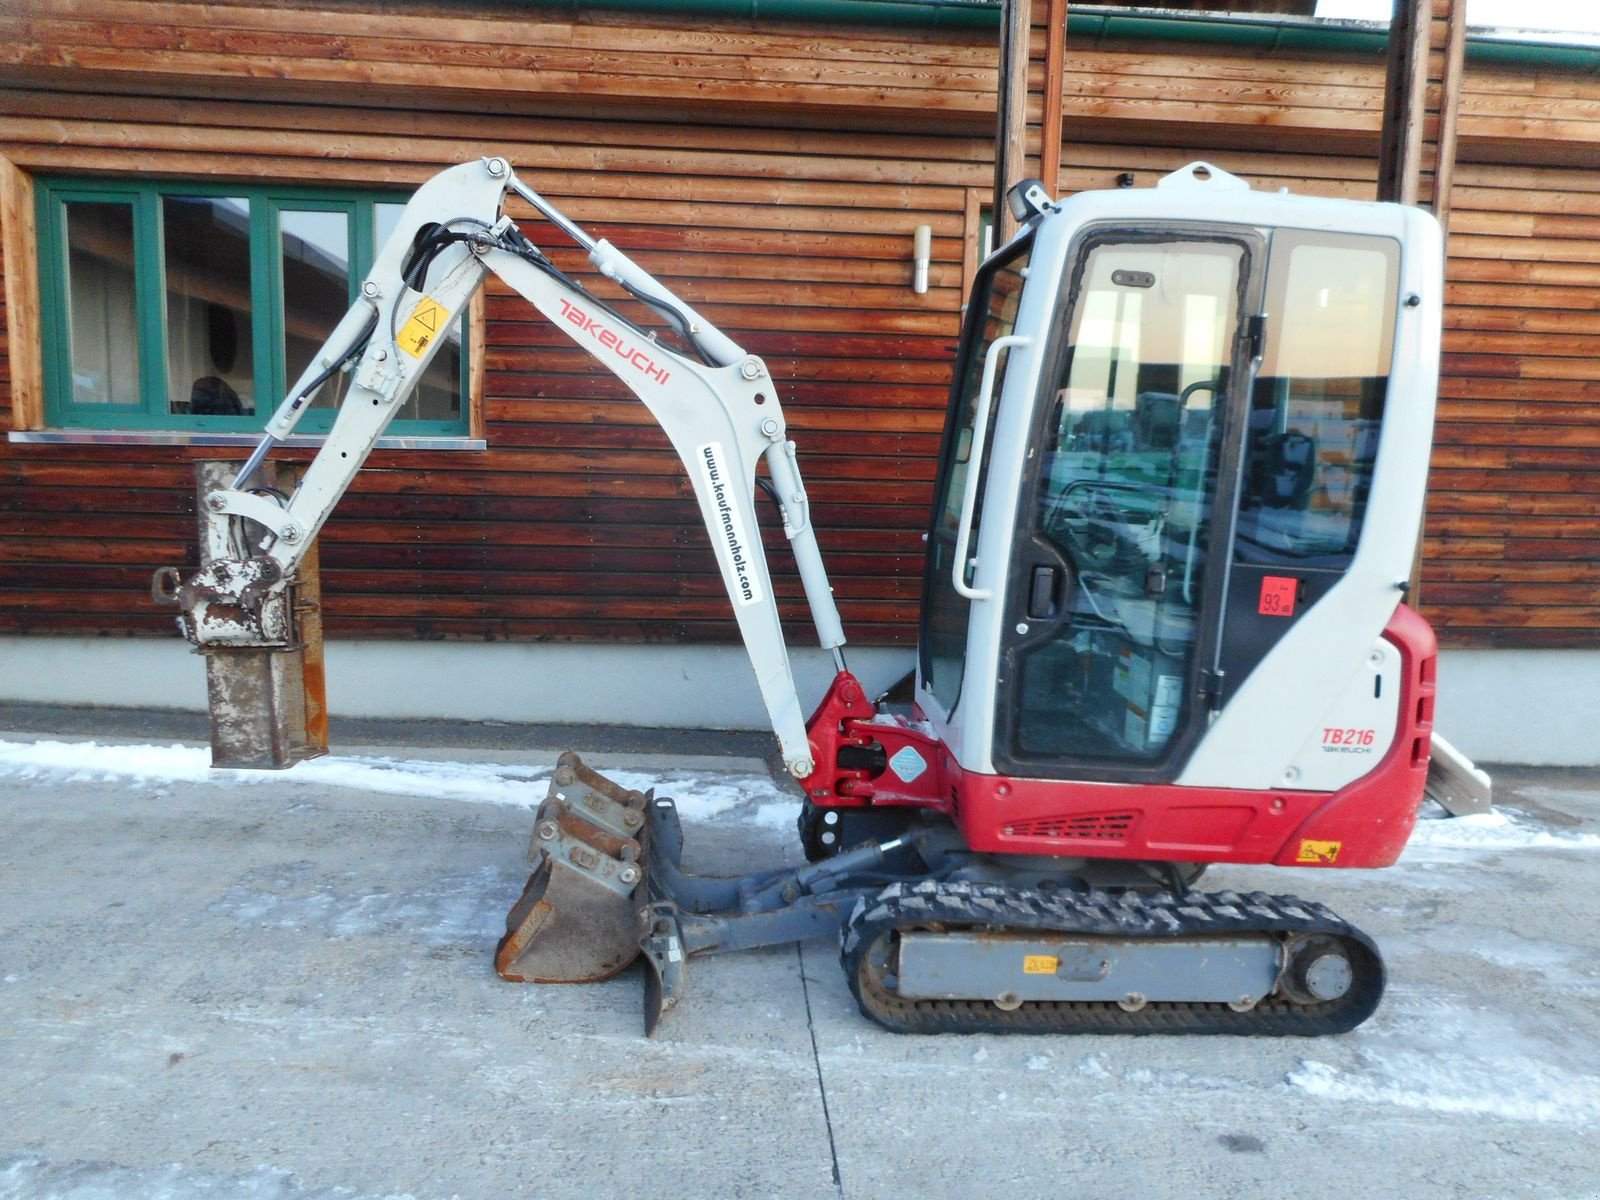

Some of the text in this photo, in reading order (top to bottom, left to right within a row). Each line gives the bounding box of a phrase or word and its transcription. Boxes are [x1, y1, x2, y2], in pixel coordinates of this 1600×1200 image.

[703, 446, 753, 601] www.kaufmannholz.com
[1263, 593, 1280, 612] 93
[1322, 728, 1376, 745] TB216
